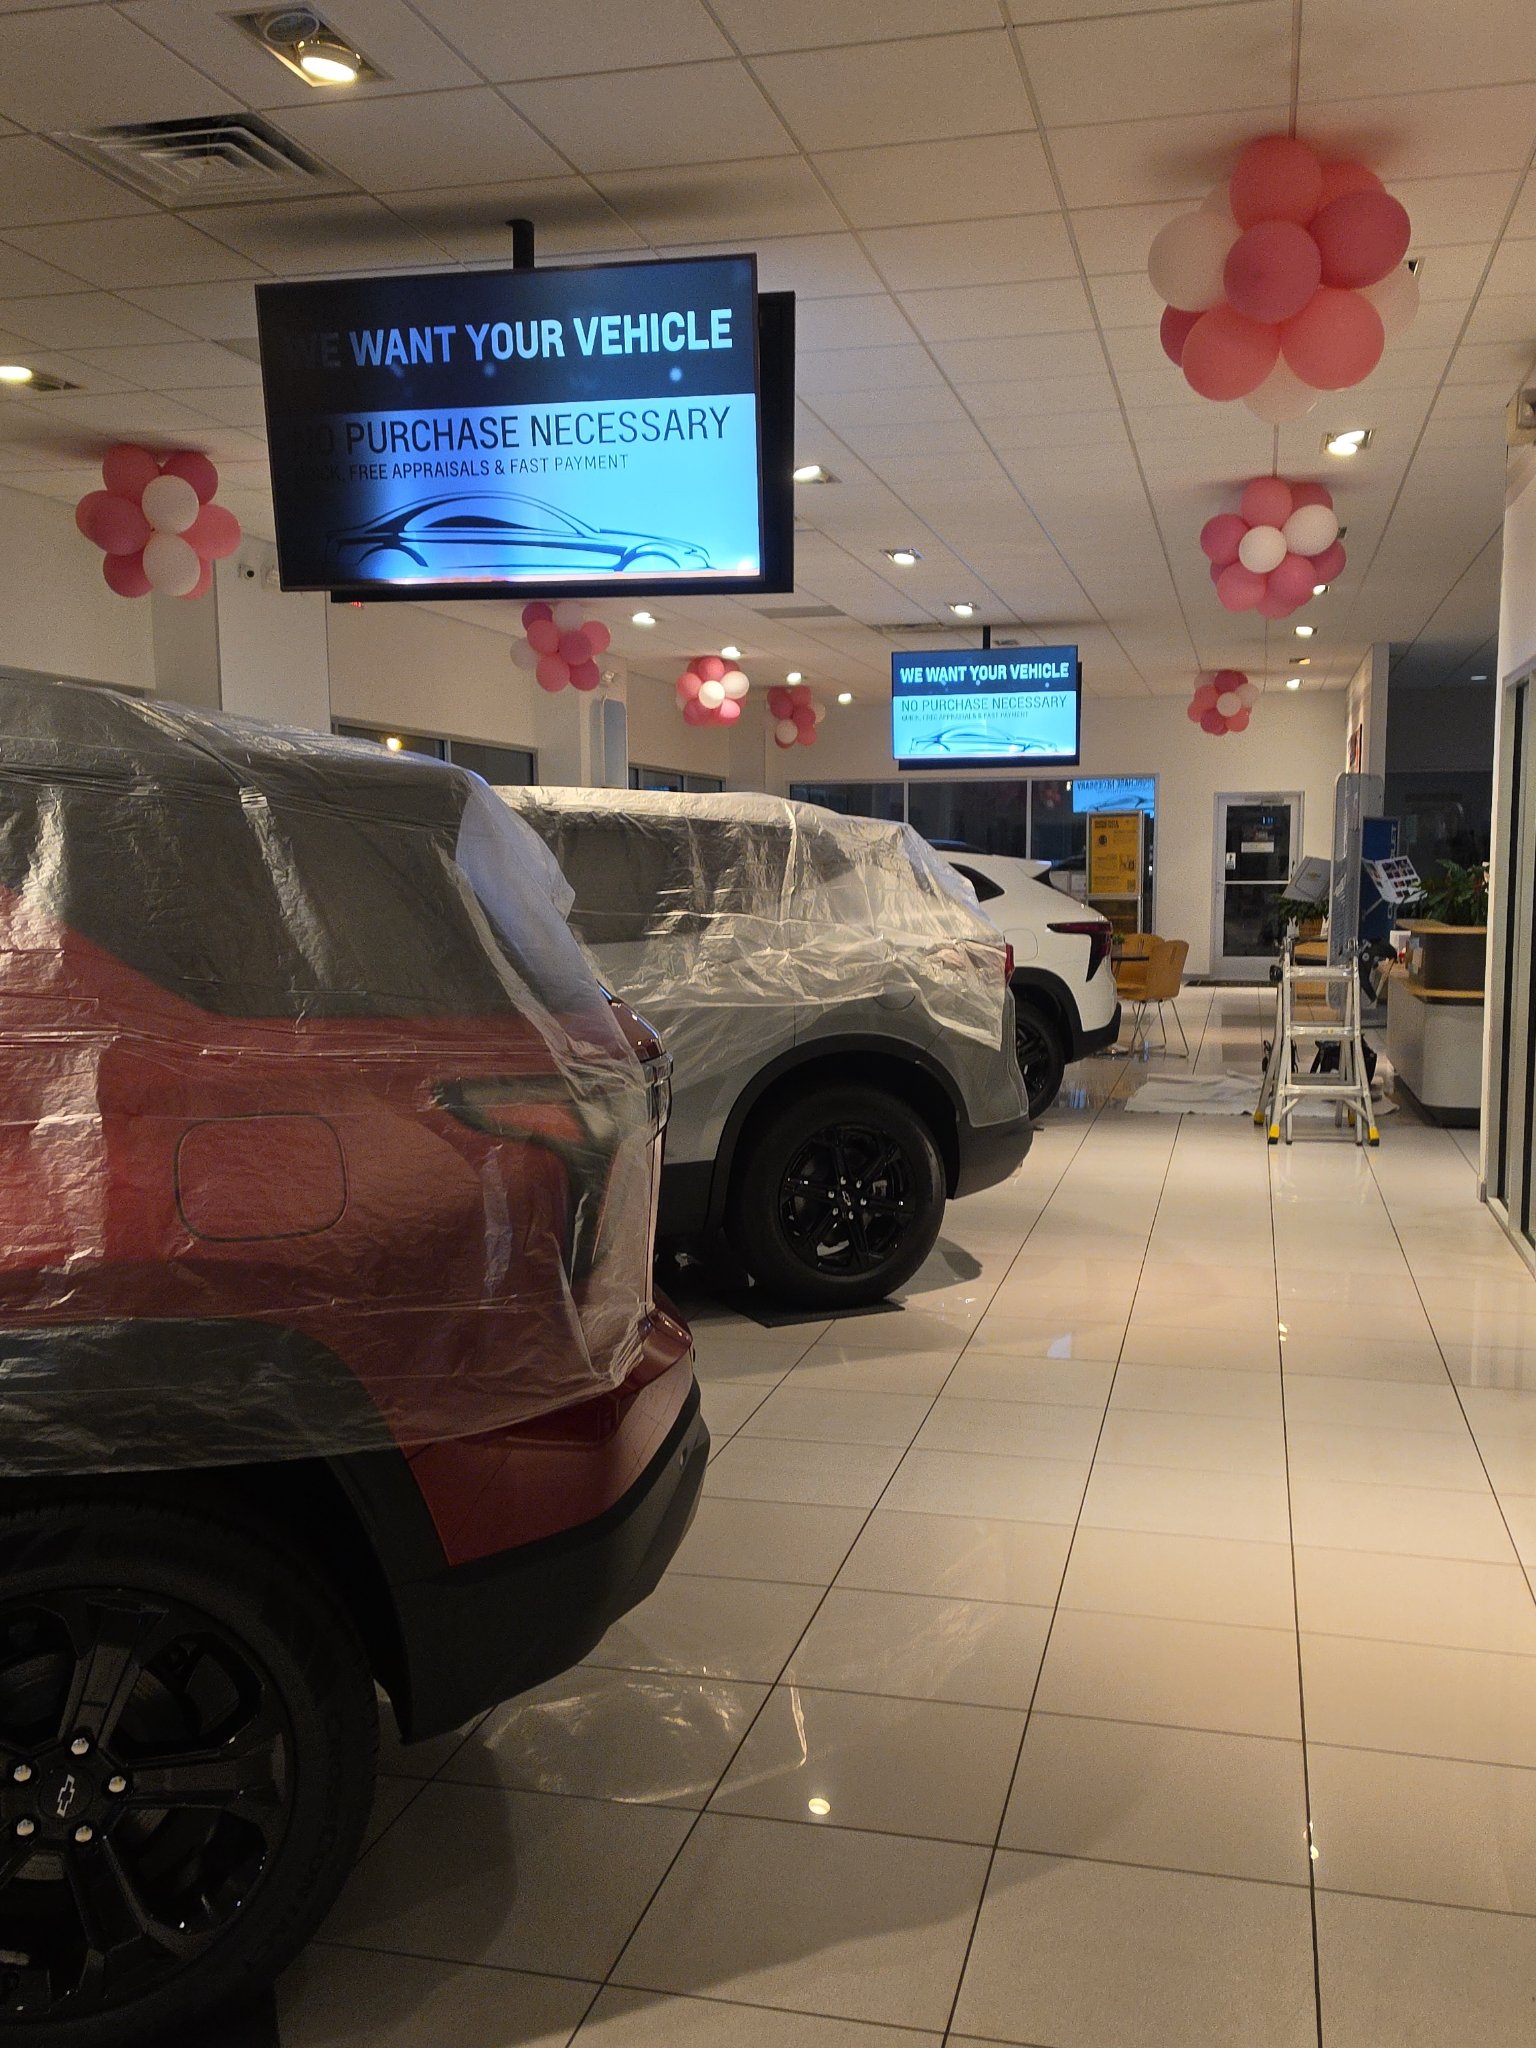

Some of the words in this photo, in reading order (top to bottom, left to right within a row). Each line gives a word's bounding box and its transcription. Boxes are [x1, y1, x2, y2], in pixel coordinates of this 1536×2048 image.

[350, 325, 456, 367] WANT
[465, 321, 565, 361] YOUR
[573, 308, 733, 356] VEHICLE
[346, 415, 519, 454] PURCHASE
[530, 406, 730, 447] NECESSARY
[350, 463, 388, 480] FREE
[392, 459, 490, 479] APPRAISALS
[495, 459, 505, 475] &
[510, 457, 549, 474] FAST
[554, 454, 628, 472] PAYMENT
[900, 667, 923, 684] WE
[926, 665, 967, 682] WANT
[969, 664, 1007, 681] YOUR
[1010, 662, 1069, 679] VEHICLE
[901, 699, 918, 712] NO
[922, 697, 989, 711] PURCHASE
[992, 695, 1067, 710] NECESSARY
